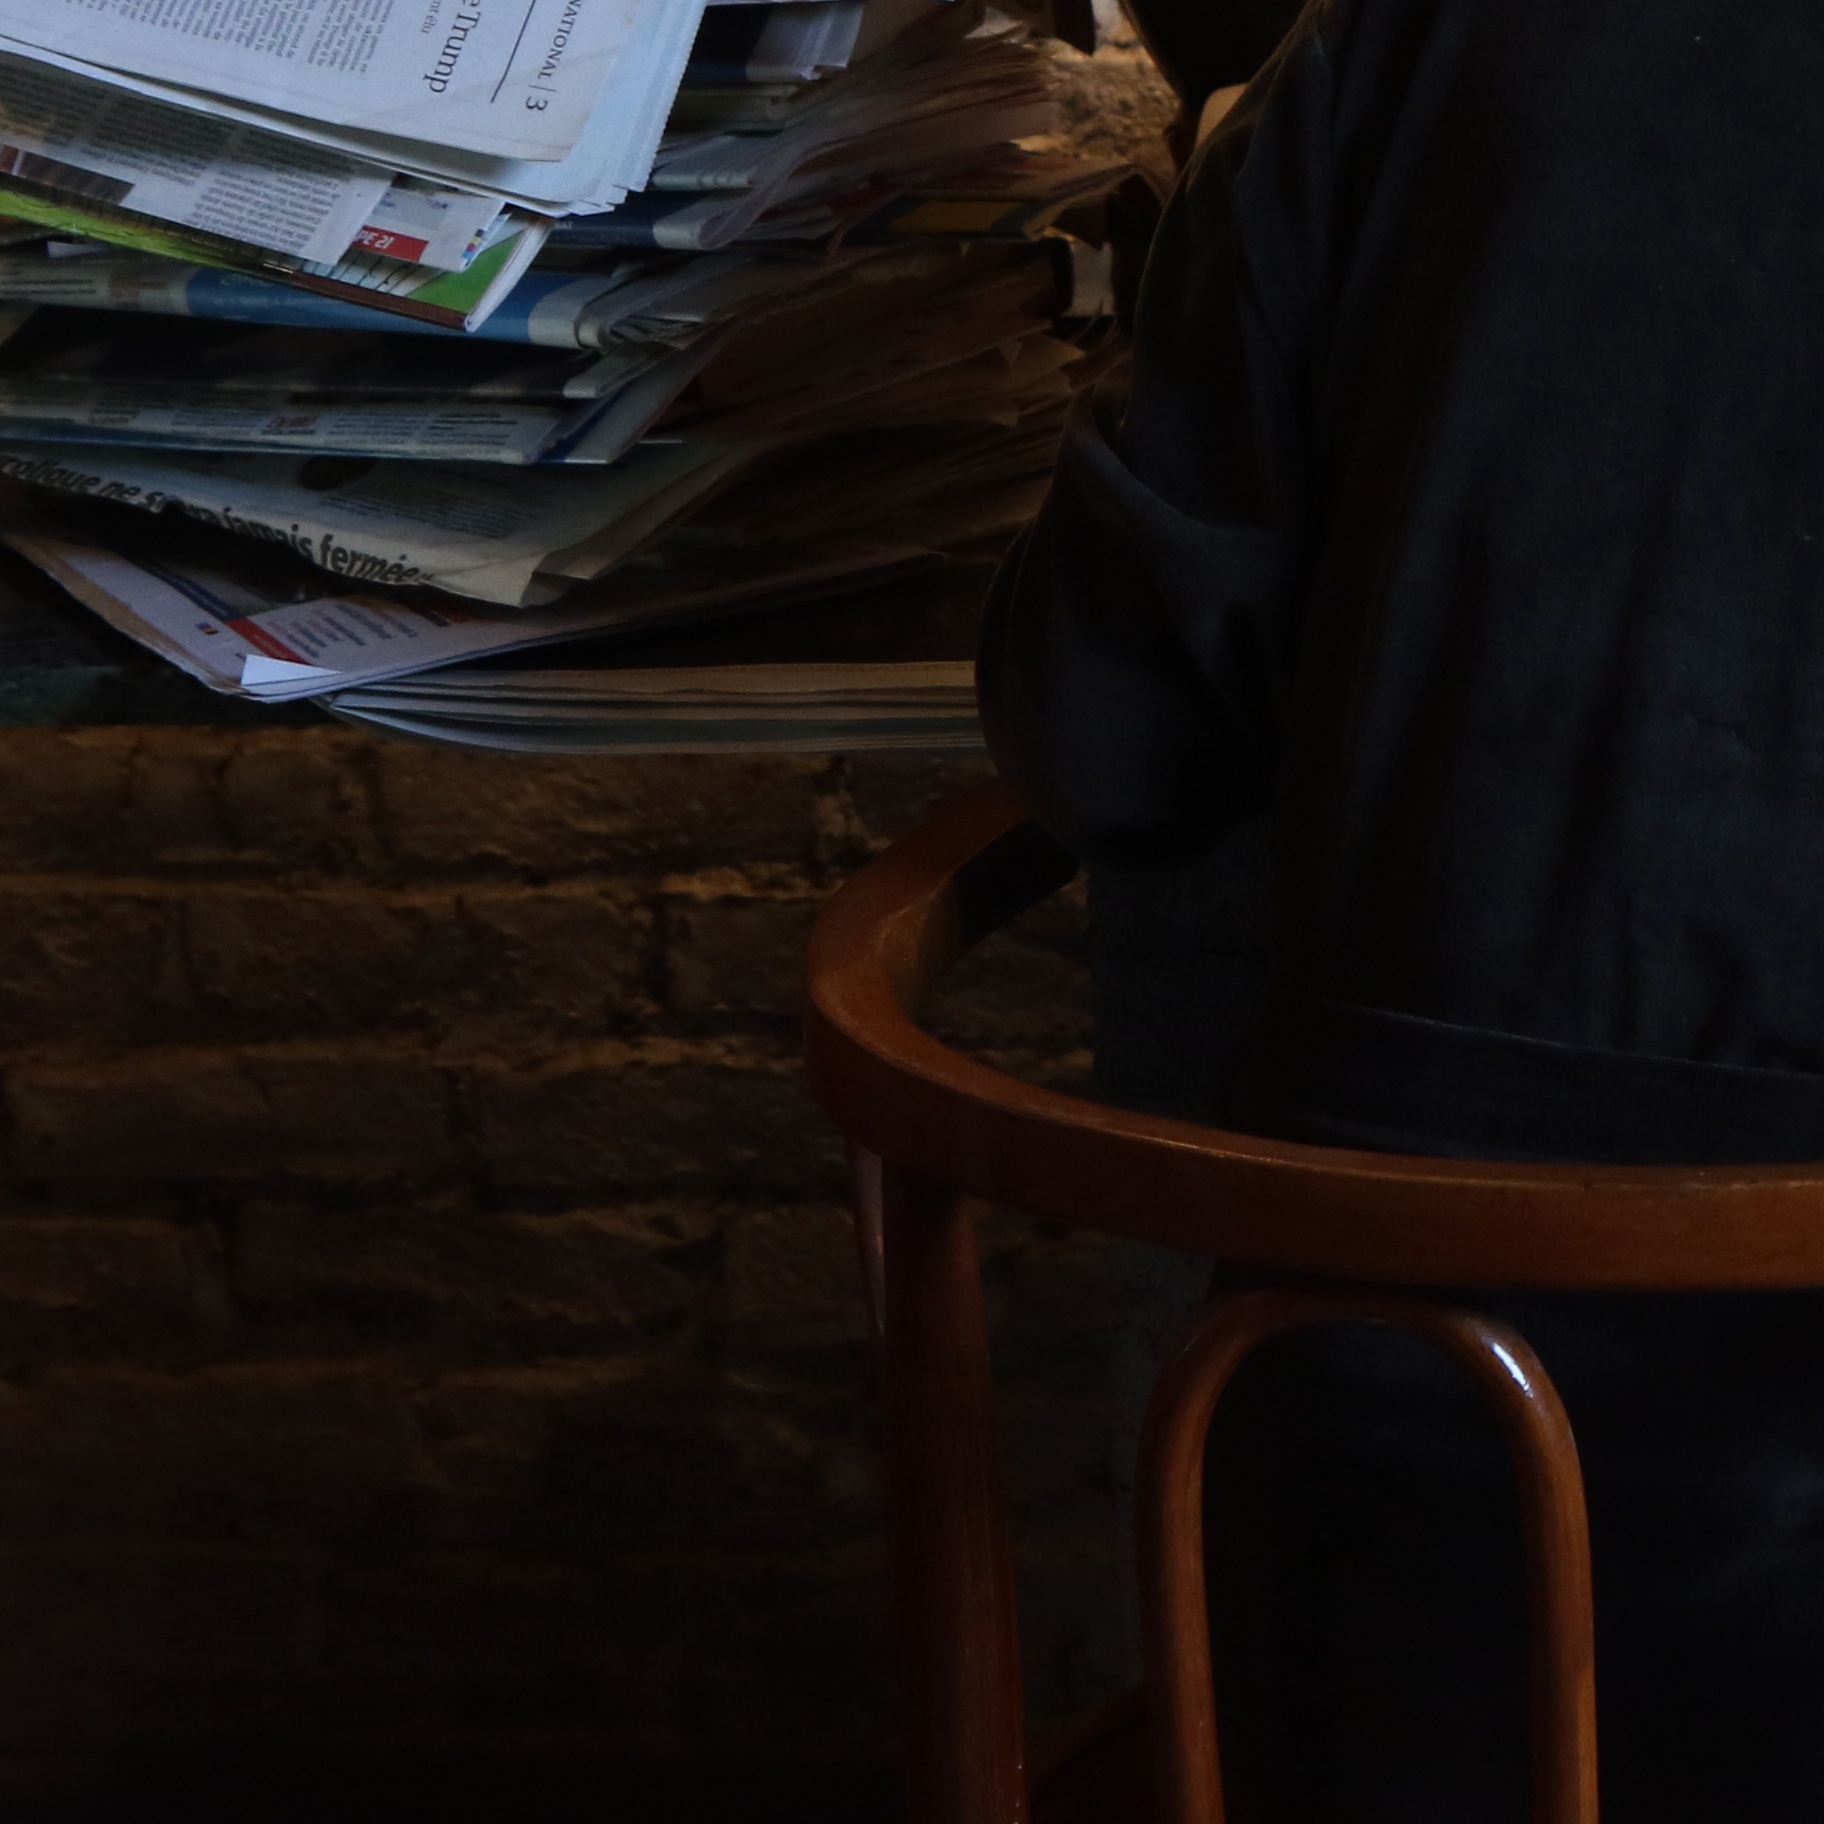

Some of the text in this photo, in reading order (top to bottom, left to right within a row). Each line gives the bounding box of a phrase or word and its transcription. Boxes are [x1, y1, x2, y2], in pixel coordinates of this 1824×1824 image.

[420, 15, 438, 34] élu
[423, 11, 482, 93] Trump
[525, 96, 549, 112] 3
